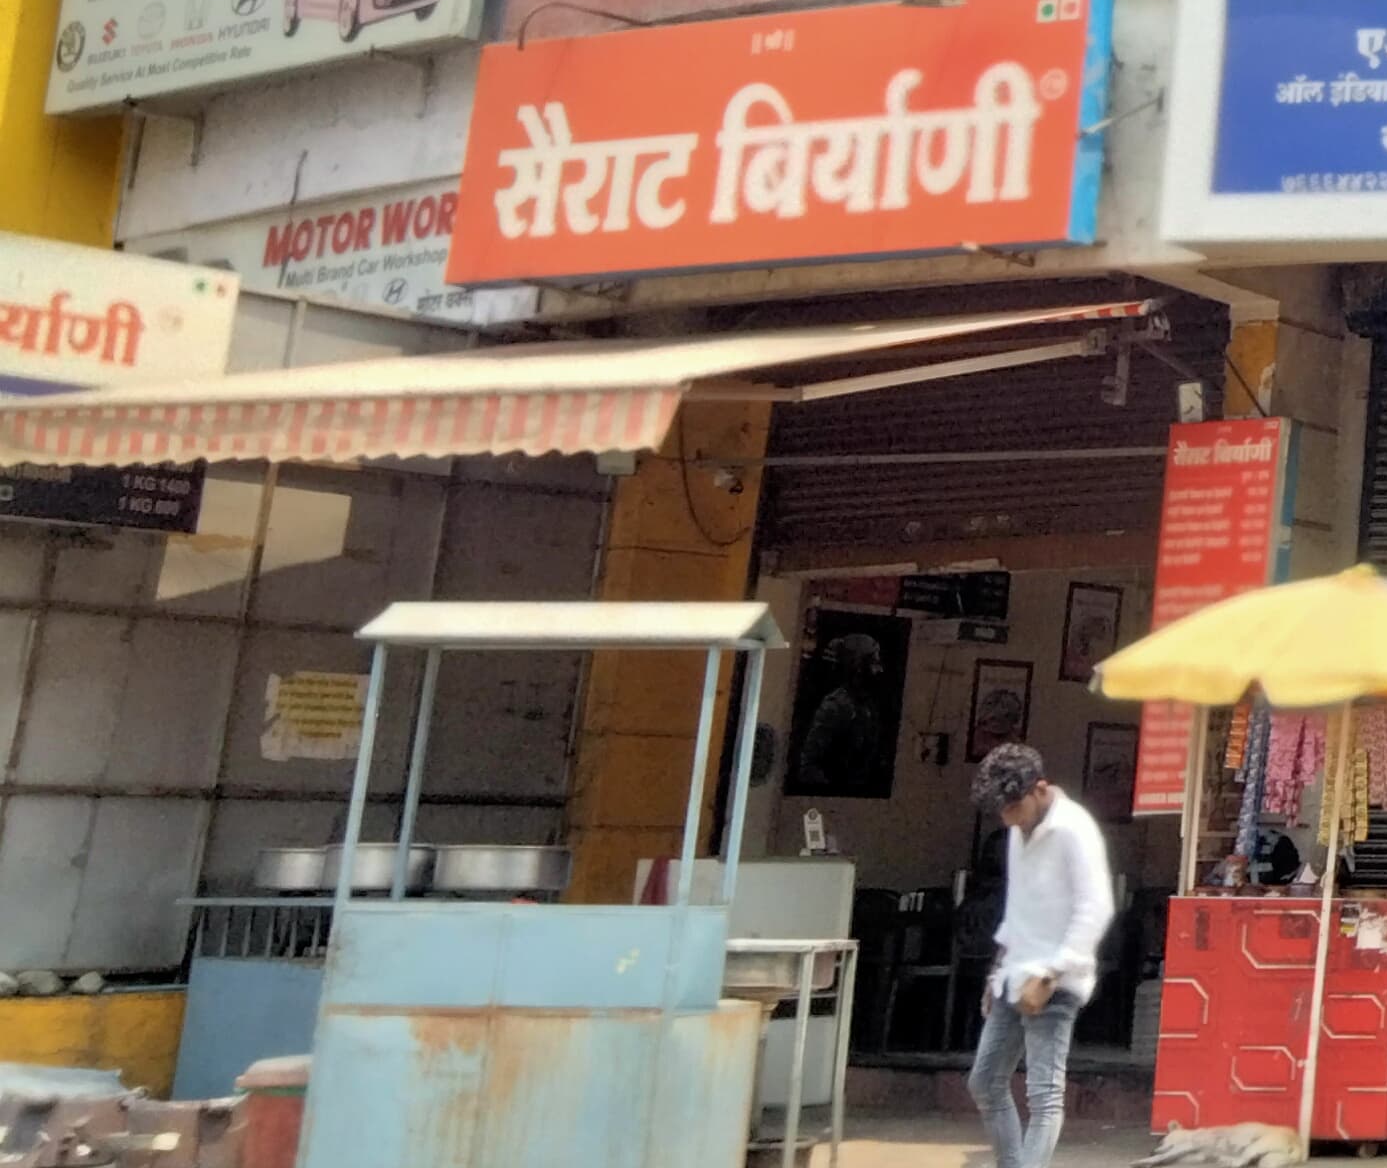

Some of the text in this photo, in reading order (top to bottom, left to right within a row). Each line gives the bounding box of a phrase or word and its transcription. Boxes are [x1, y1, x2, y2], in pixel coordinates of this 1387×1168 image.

[1276, 74, 1326, 104] ऑल
[495, 61, 1043, 239] सैराट बिर्याणी
[262, 207, 375, 268] MOTOR
[286, 246, 447, 288] Multi Brand Car Workshop
